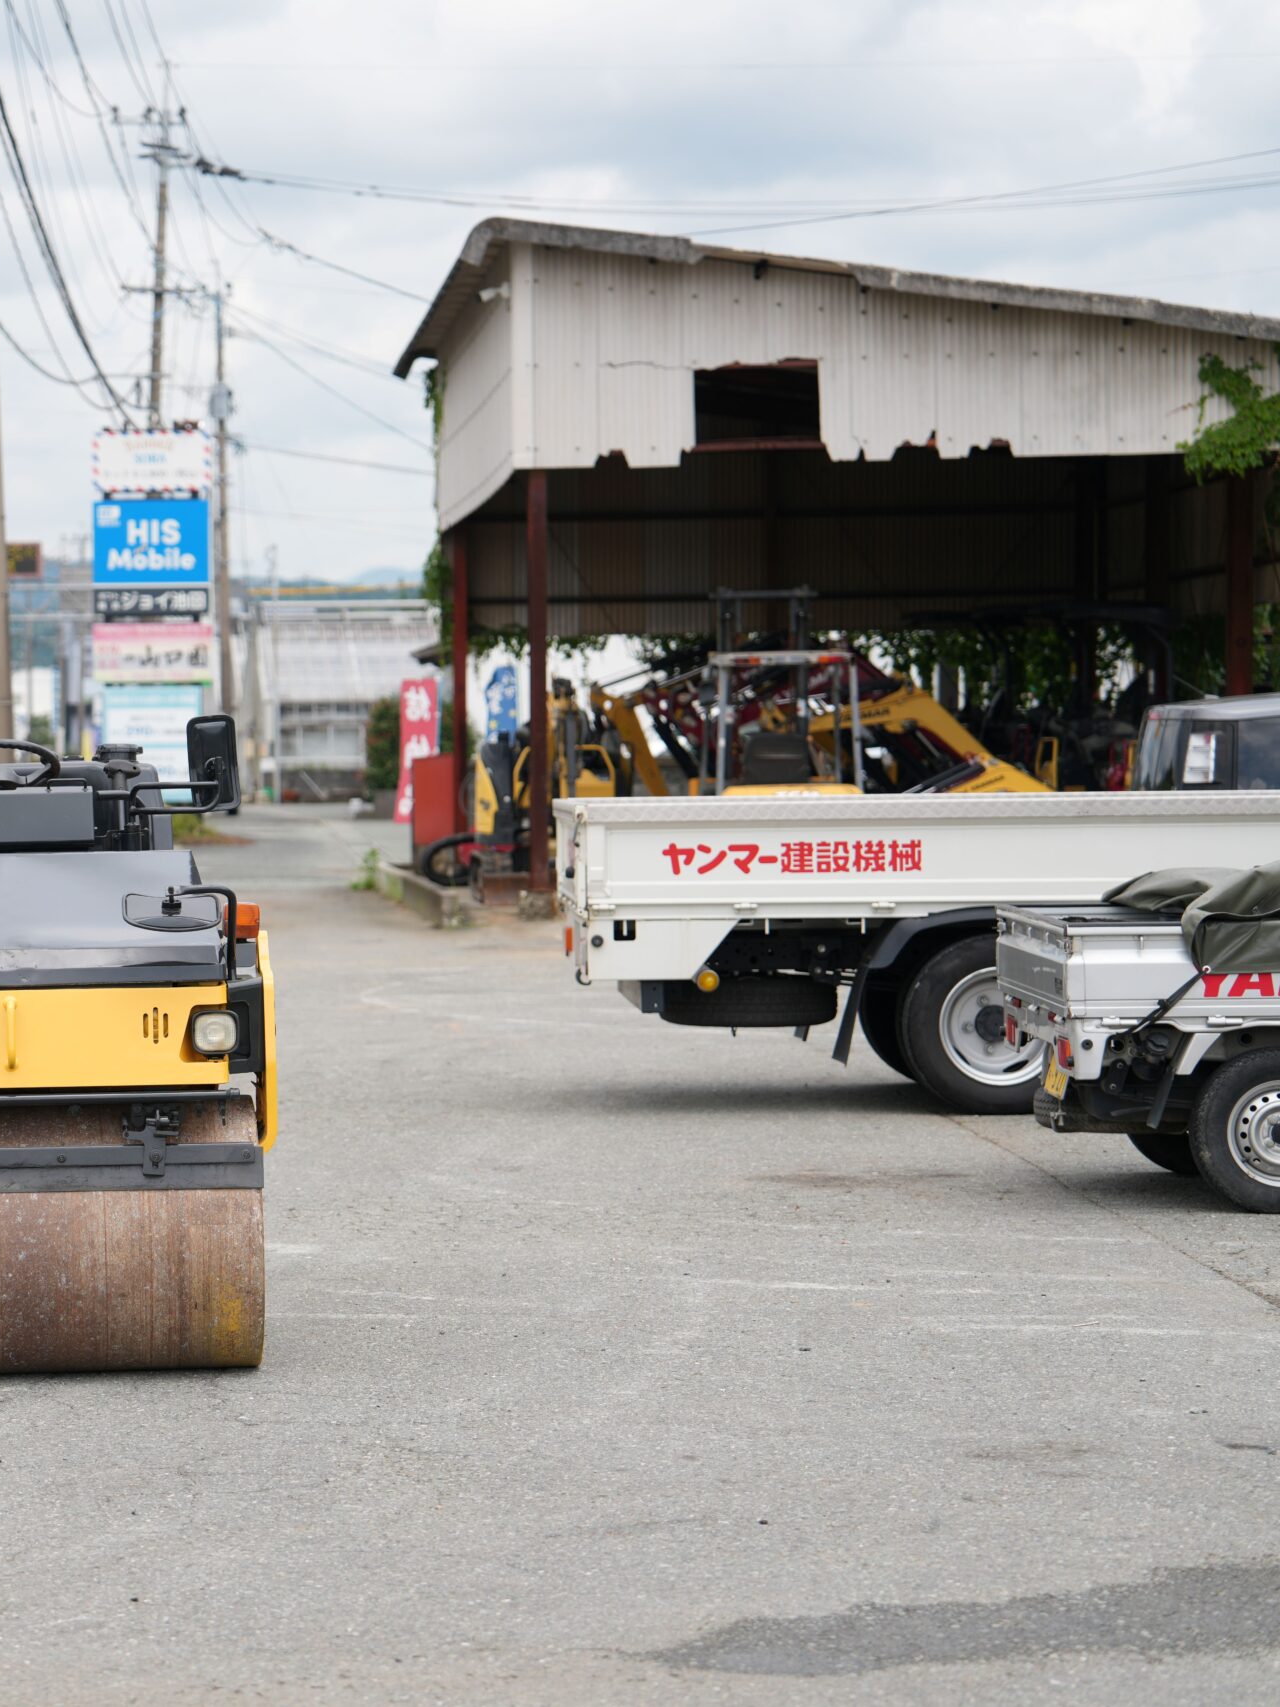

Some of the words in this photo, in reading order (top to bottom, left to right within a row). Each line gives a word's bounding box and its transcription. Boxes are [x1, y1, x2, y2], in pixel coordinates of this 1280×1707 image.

[127, 519, 181, 545] HIS
[107, 547, 197, 571] Mobile
[662, 839, 921, 876] ヤンマー建設機械
[1201, 973, 1280, 998] YA
